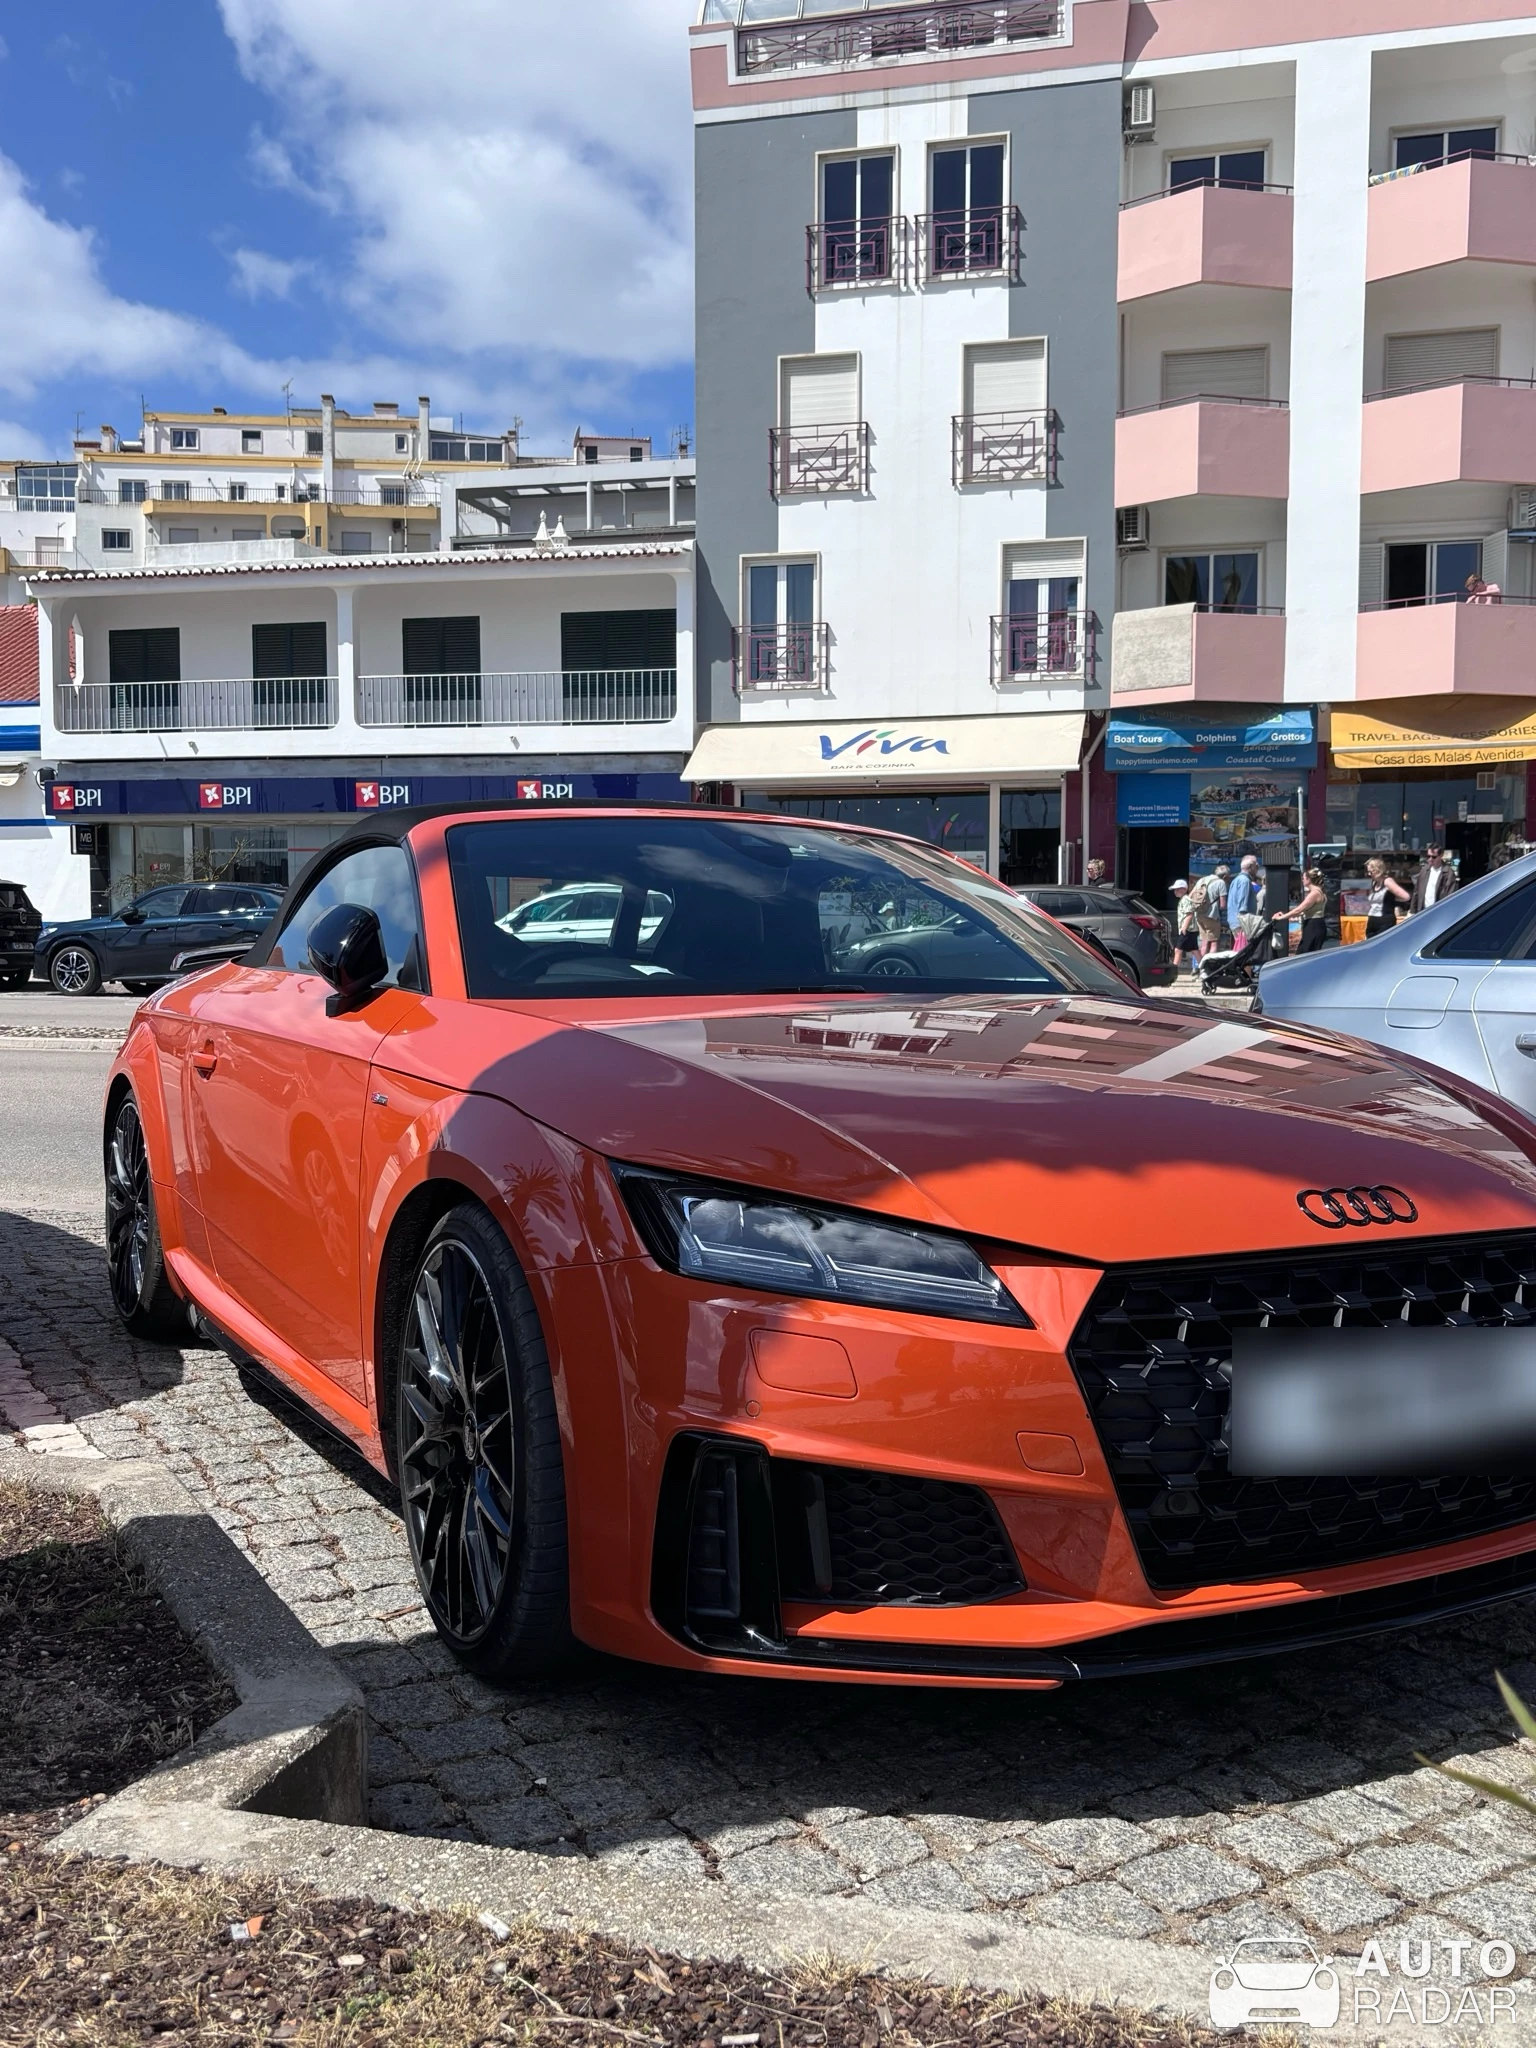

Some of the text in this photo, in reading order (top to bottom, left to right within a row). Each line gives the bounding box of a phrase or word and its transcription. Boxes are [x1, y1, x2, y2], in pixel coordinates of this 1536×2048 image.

[1113, 733, 1163, 744] Boat Tours
[1196, 733, 1237, 745] Dolphins
[1271, 732, 1306, 742] Grottos
[1350, 733, 1400, 742] TRAVEL
[1402, 733, 1441, 741] BAGS
[819, 729, 950, 760] Viva
[1115, 756, 1198, 767] happytimeturismo.com
[1225, 755, 1296, 764] Coastal Cruise
[1374, 748, 1524, 766] Casa das Malas Avenida
[74, 788, 102, 807] BPI
[222, 786, 251, 805] BPI
[379, 785, 408, 804] BPI
[79, 832, 92, 843] MB
